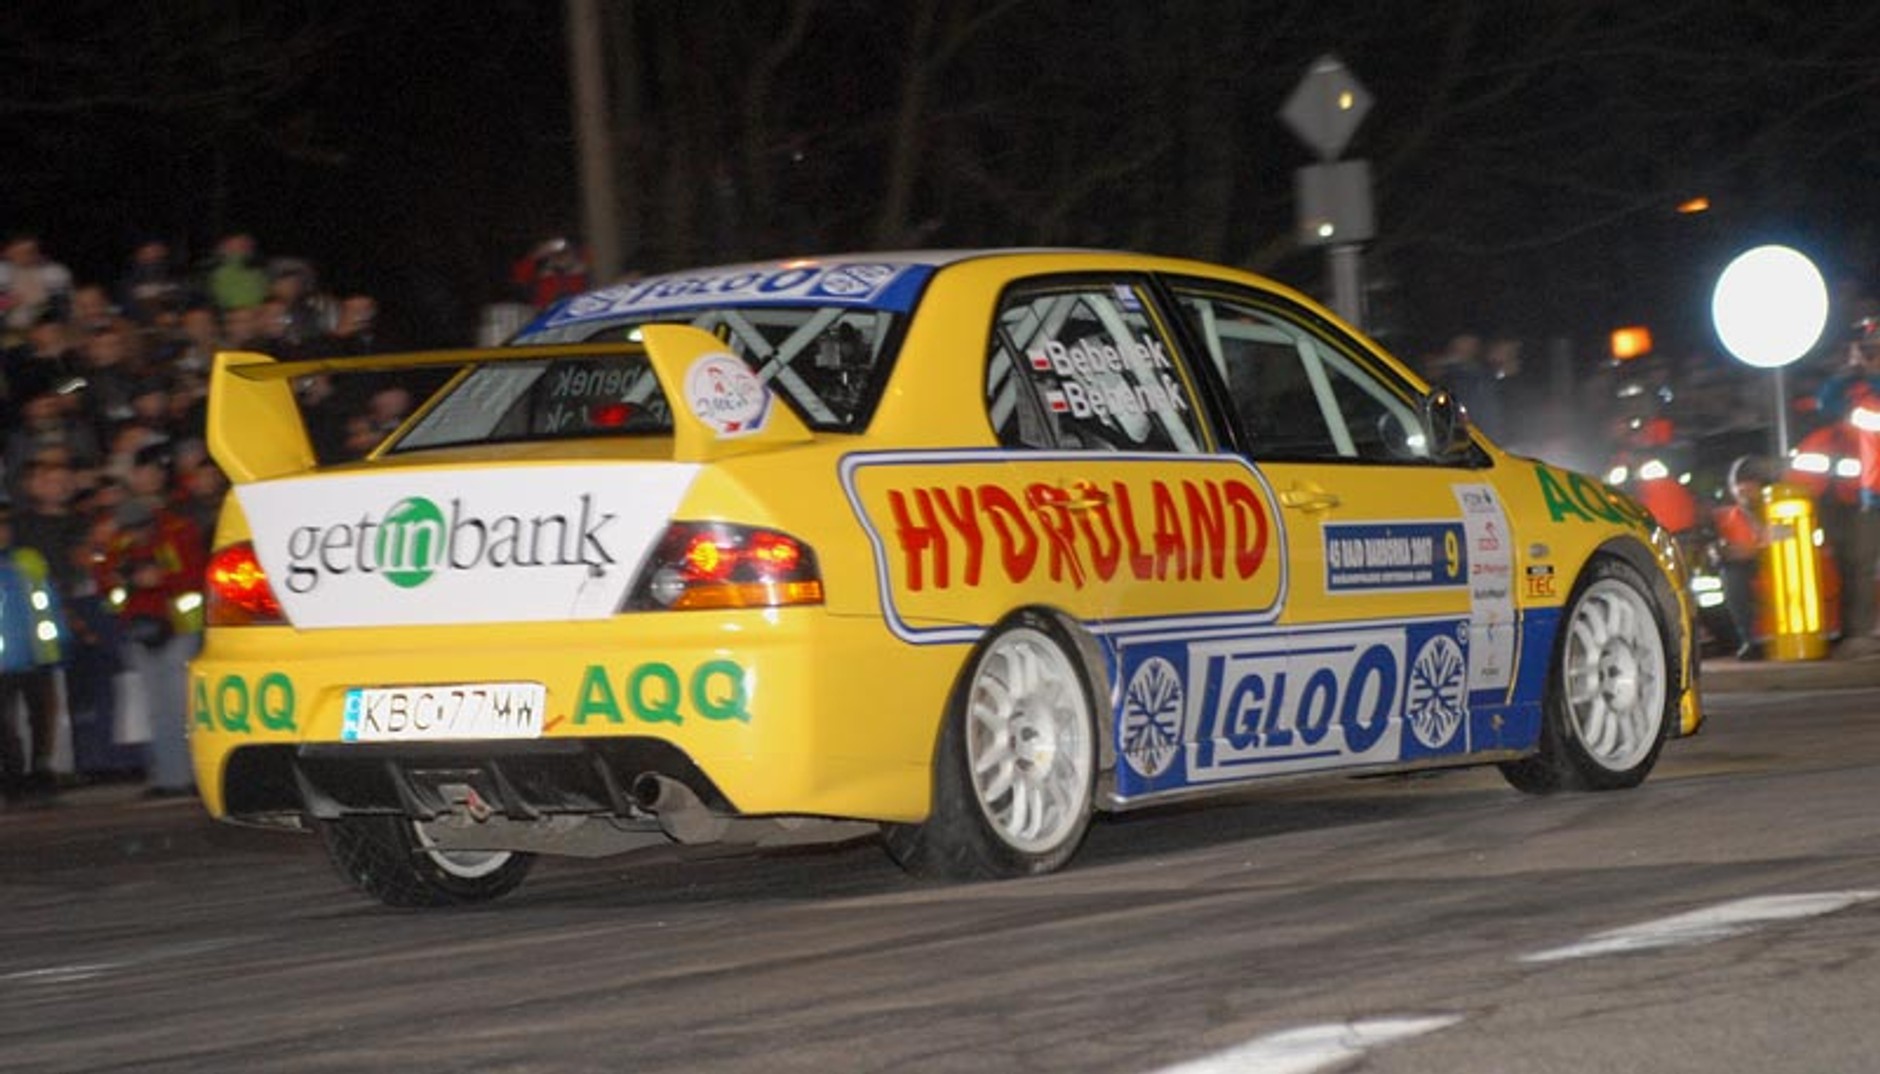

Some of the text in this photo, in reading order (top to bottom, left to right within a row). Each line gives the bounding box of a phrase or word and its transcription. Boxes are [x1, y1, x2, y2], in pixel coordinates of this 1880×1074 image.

[284, 493, 618, 594] getinbank
[886, 479, 1269, 592] HYDROLAND
[1445, 530, 1459, 577] 9
[571, 660, 752, 727] AQQ
[1195, 643, 1398, 769] IGLOO
